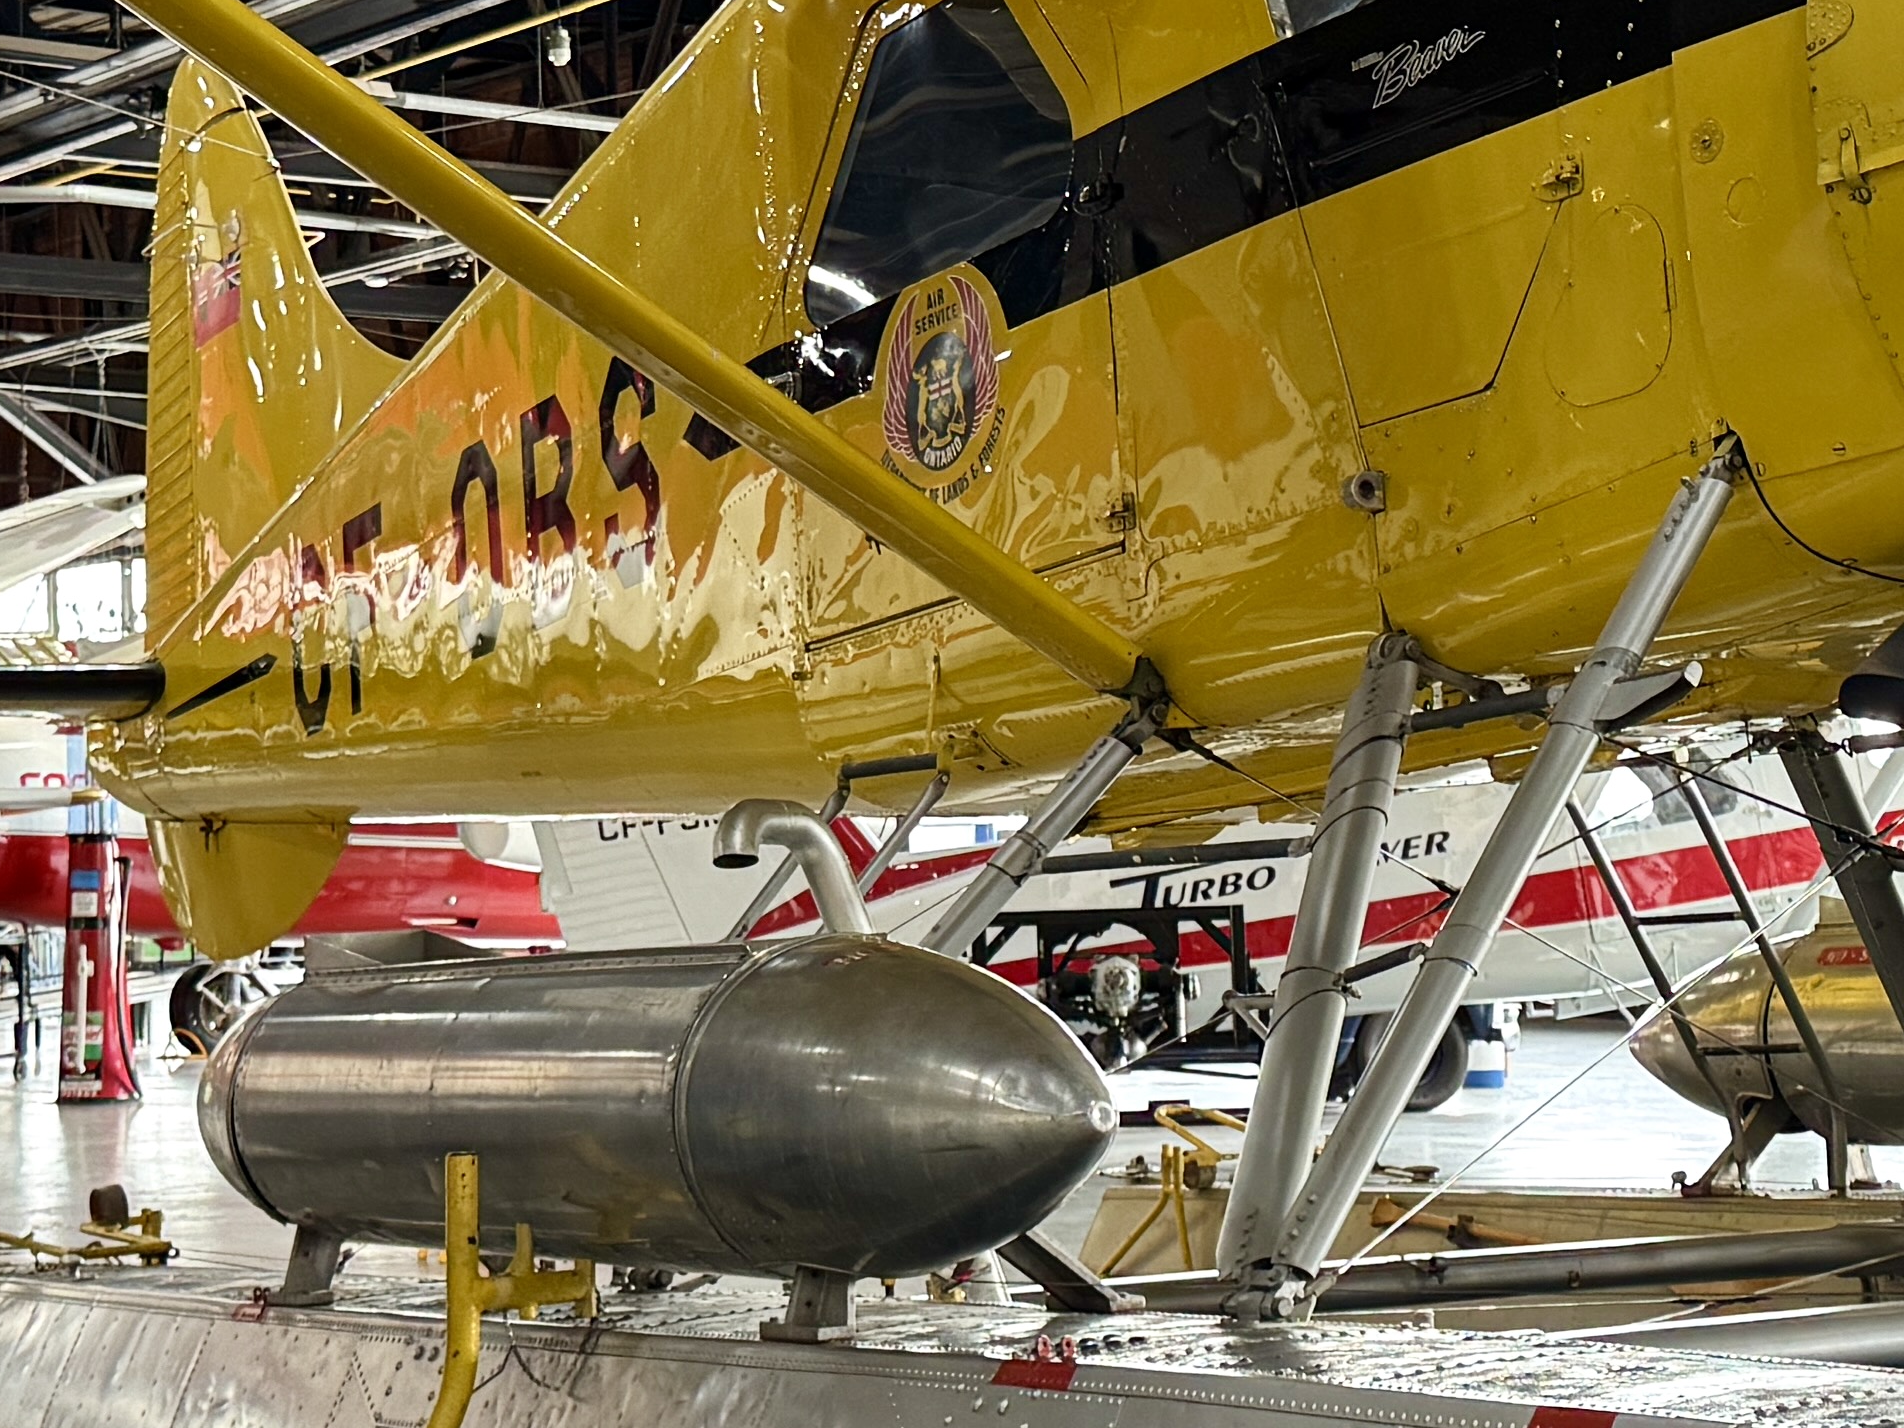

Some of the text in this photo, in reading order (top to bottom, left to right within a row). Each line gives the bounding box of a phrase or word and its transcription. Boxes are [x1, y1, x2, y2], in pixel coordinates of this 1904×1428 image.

[927, 288, 944, 311] AIR
[914, 303, 958, 336] SERVICE
[923, 435, 963, 468] ONTARIO
[1109, 860, 1277, 910] TURBO
